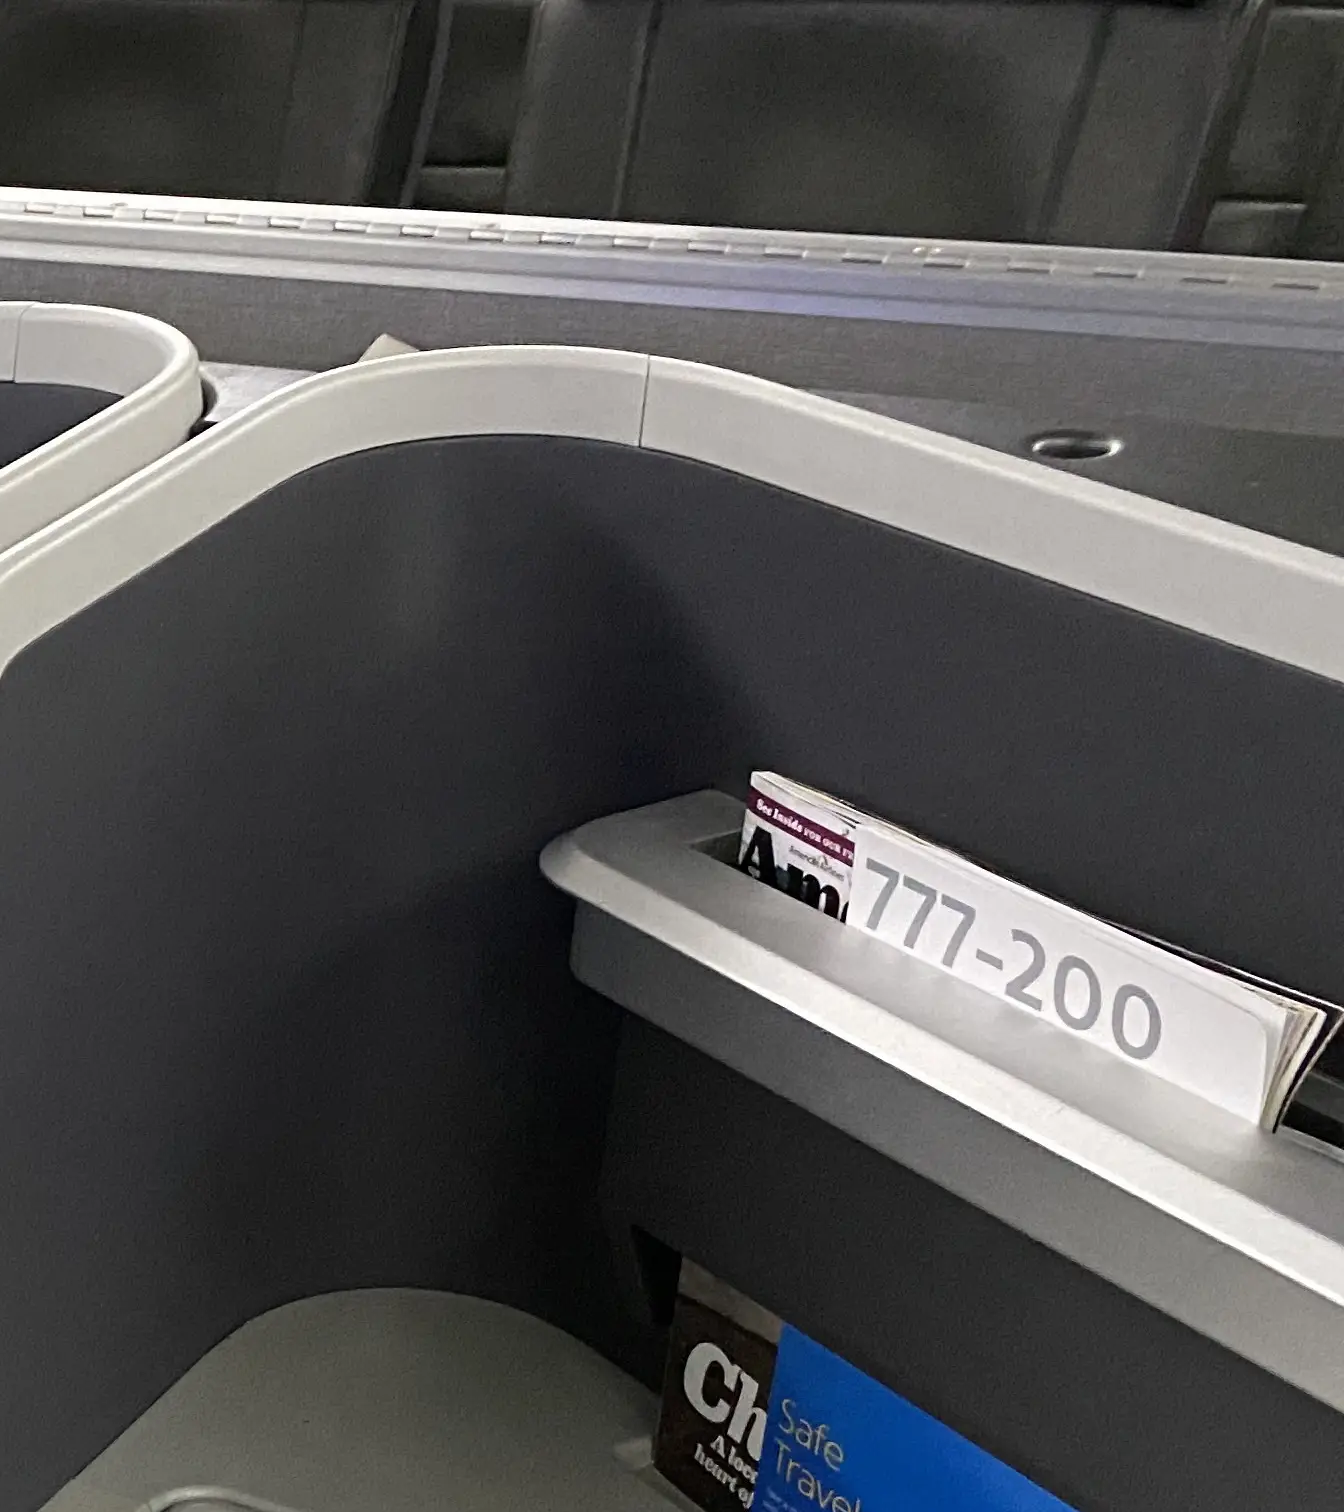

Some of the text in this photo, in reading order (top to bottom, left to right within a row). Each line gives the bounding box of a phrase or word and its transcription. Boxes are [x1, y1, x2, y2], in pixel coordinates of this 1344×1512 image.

[739, 825, 849, 924] Am
[865, 857, 1162, 1060] 777-200
[694, 1442, 738, 1494] heart
[710, 1435, 726, 1459] A
[778, 1398, 844, 1472] Safe
